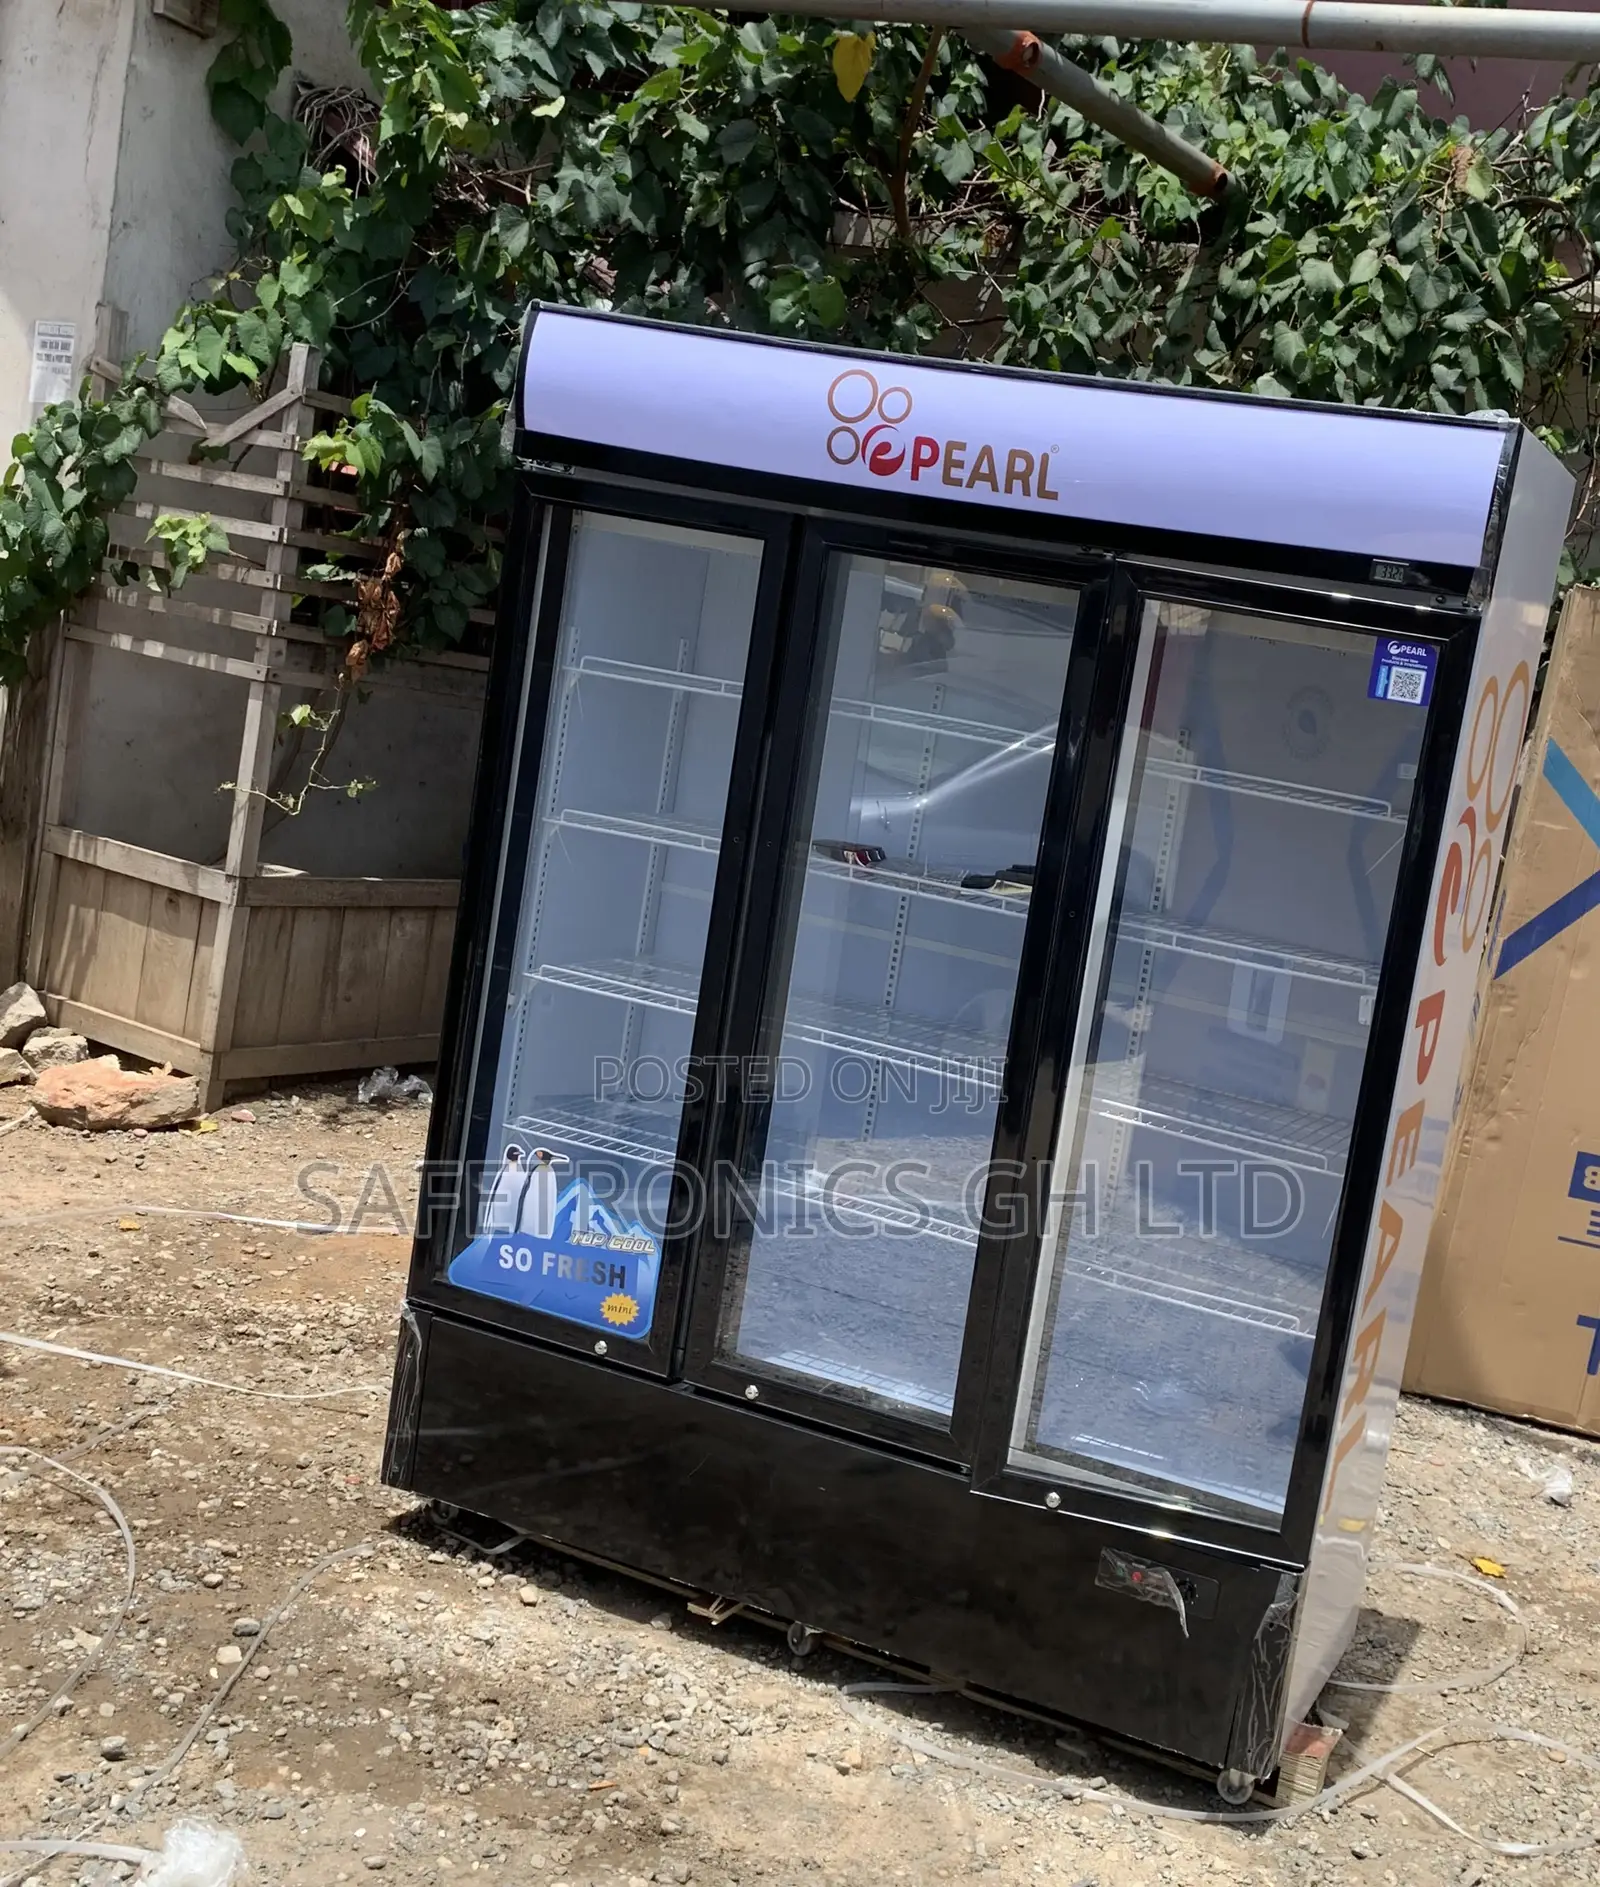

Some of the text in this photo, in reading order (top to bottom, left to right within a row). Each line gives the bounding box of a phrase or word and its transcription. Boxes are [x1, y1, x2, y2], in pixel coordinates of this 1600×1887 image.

[911, 436, 1059, 501] PEARL
[1400, 645, 1427, 657] PEARL
[571, 1230, 656, 1255] TOP COOL
[499, 1244, 626, 1289] SO FRESH
[607, 1302, 633, 1315] mini
